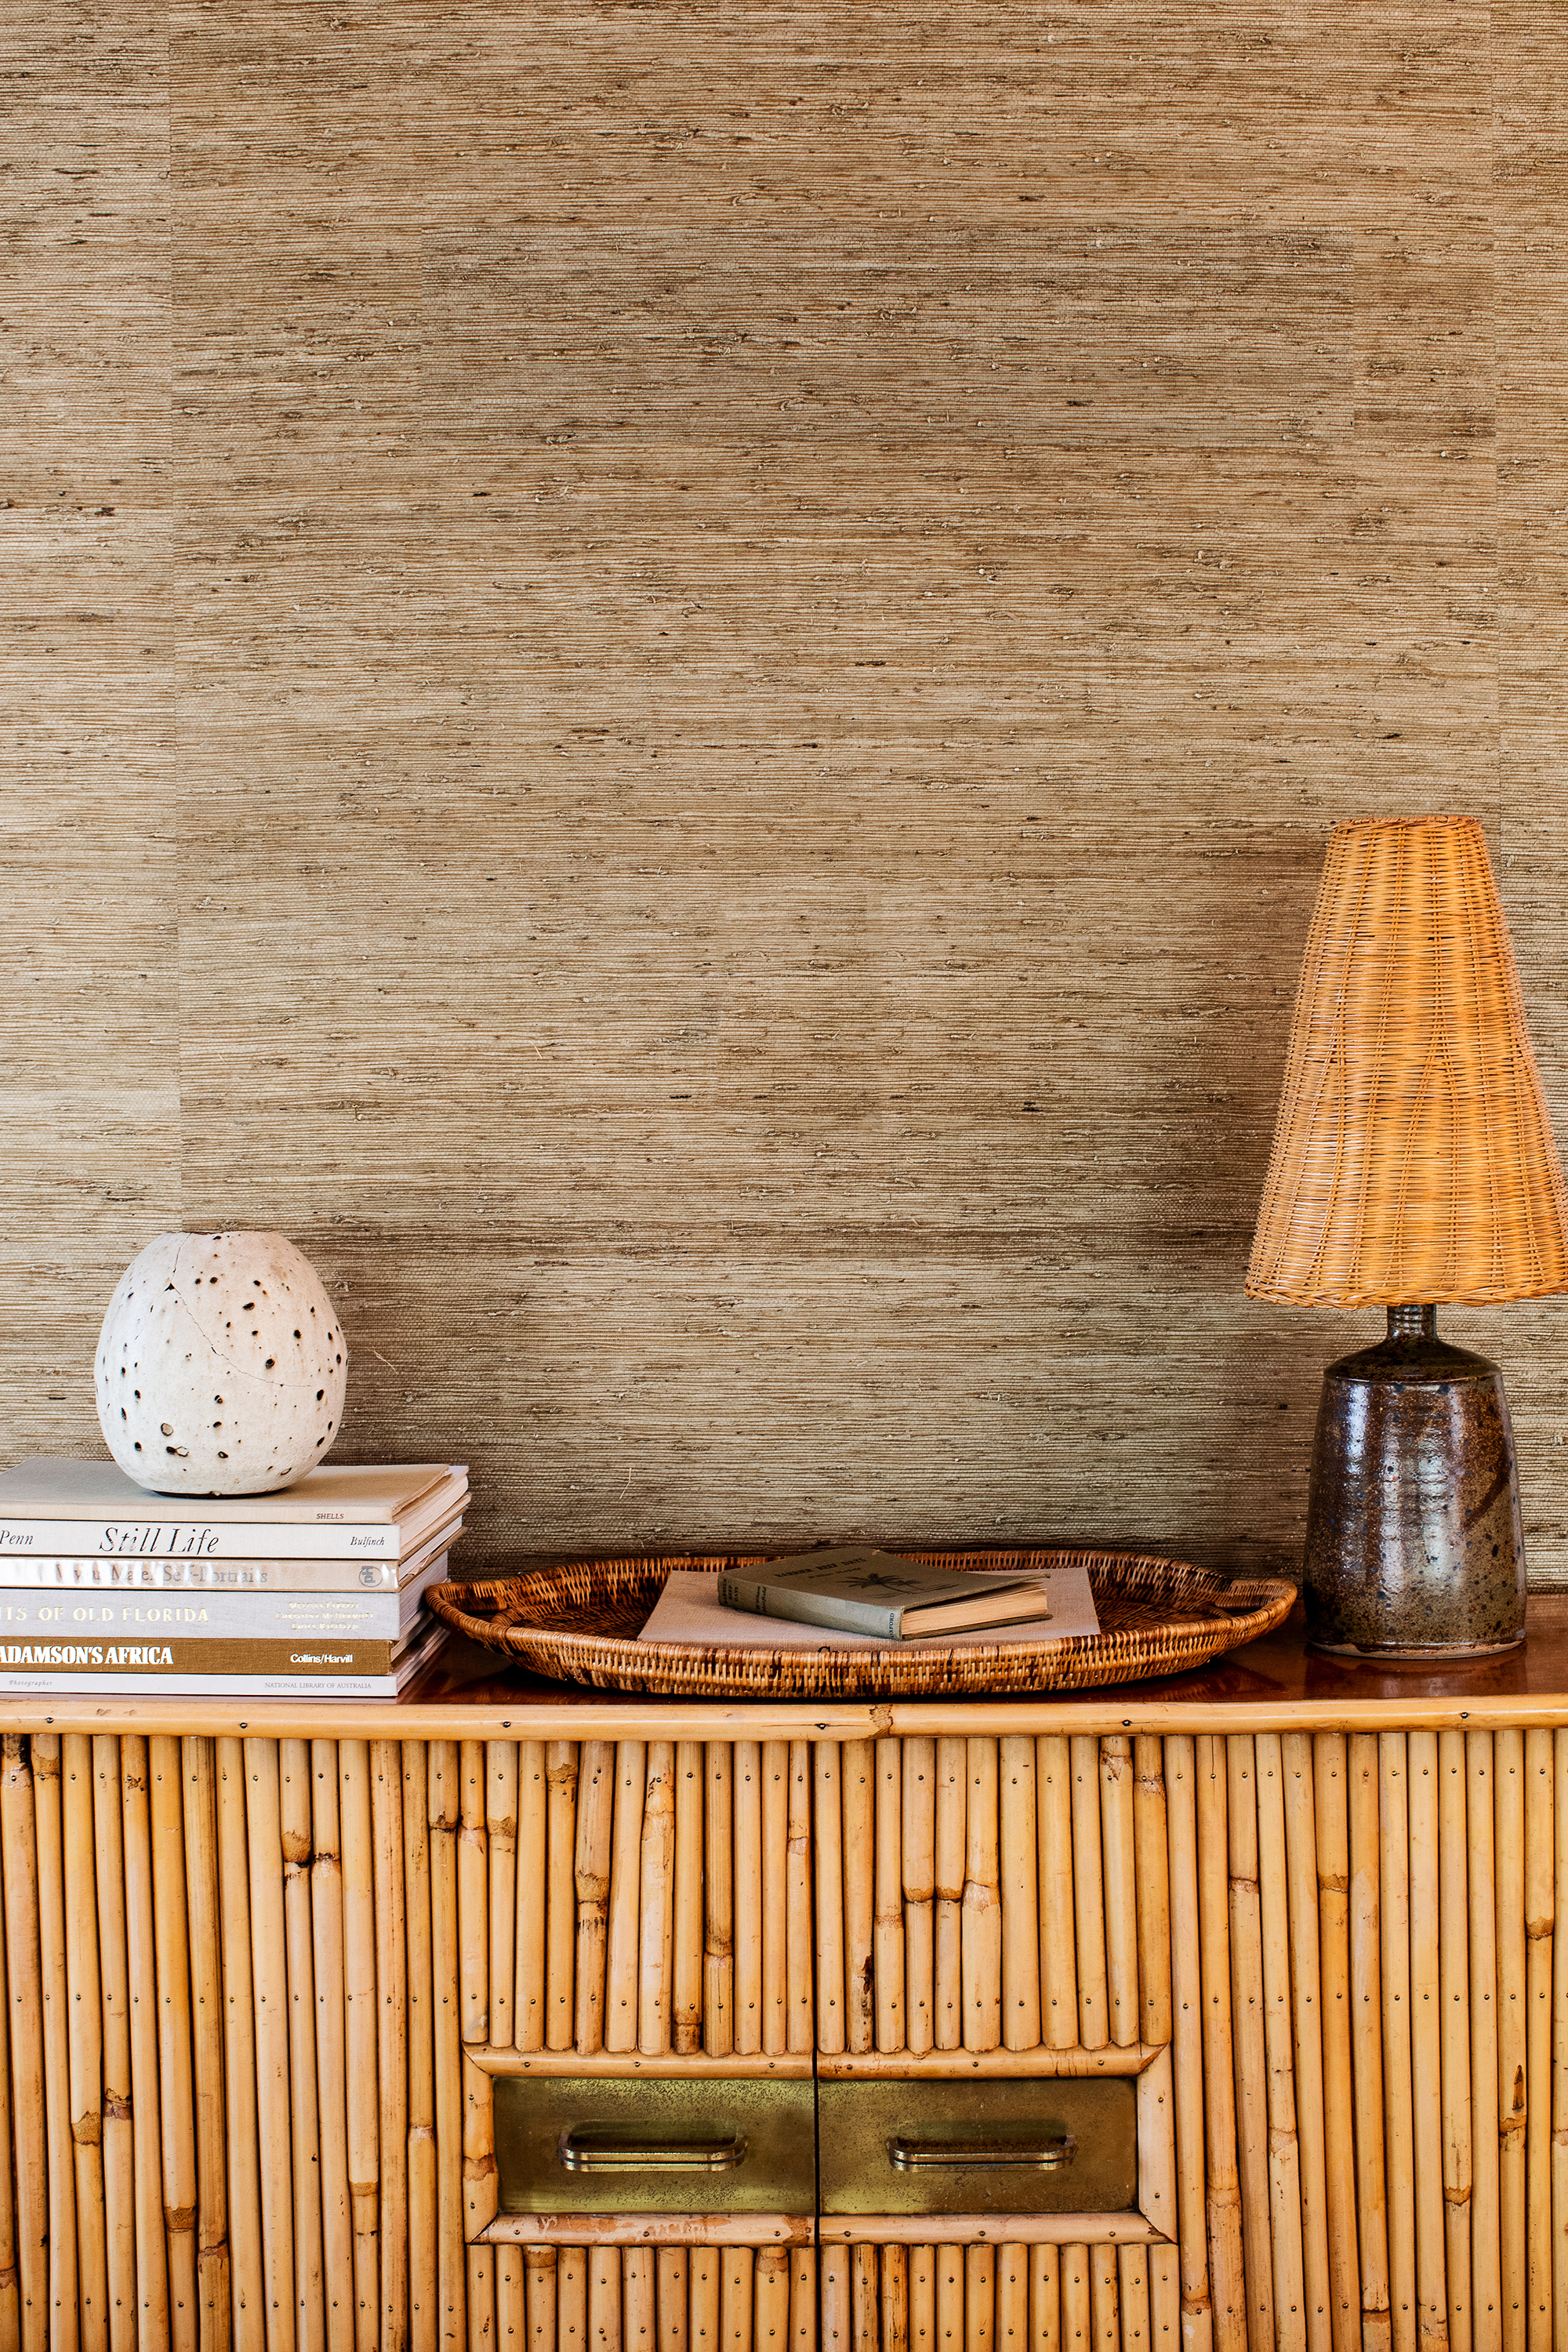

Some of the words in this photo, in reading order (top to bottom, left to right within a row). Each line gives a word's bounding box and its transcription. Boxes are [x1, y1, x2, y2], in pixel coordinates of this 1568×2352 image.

[0, 1530, 34, 1545] Penn
[99, 1526, 162, 1552] Still
[166, 1528, 220, 1555] Life
[350, 1536, 386, 1548] Bulfinch
[0, 1606, 27, 1621] TS
[38, 1606, 64, 1621] OF
[73, 1607, 114, 1621] OLD
[122, 1607, 209, 1622] FLORIDA
[105, 1646, 174, 1664] AFRICA
[290, 1653, 354, 1664] Collins/Harvill
